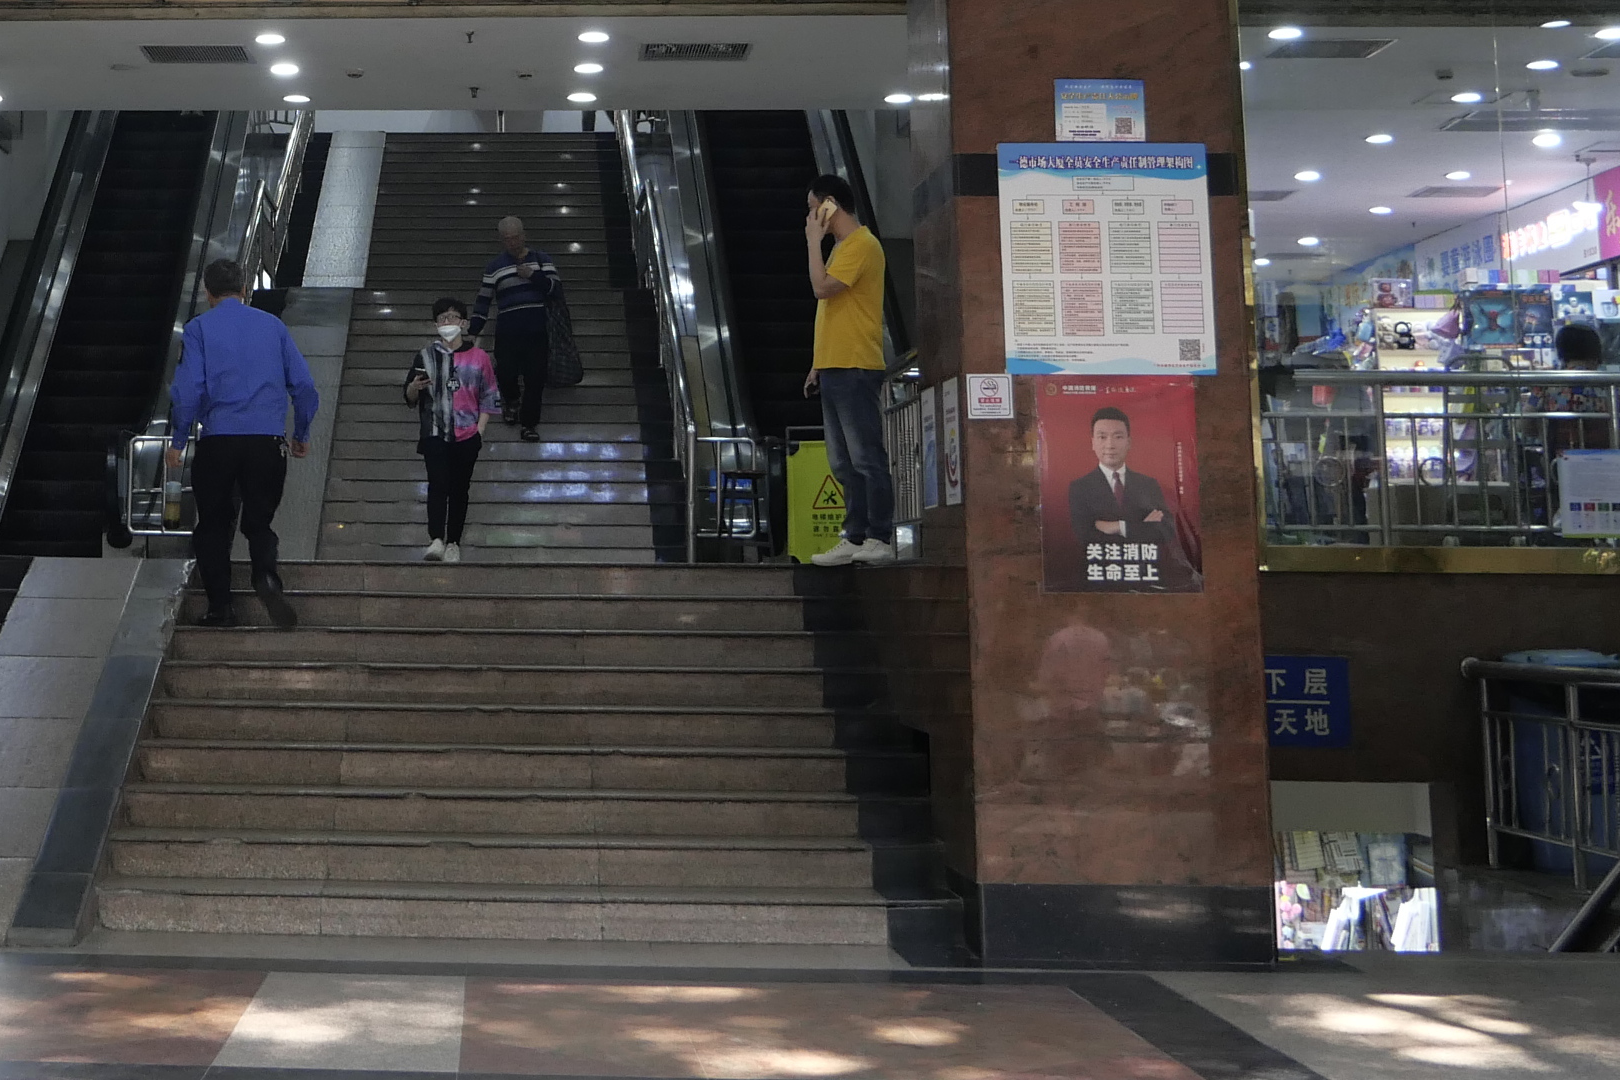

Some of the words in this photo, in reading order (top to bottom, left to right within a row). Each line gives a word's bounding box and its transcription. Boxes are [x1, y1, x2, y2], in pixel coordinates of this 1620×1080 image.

[1086, 543, 1159, 562] 关注消防
[1087, 564, 1160, 582] 生命至上
[1264, 668, 1328, 695] 下层
[1273, 707, 1330, 736] 天地
